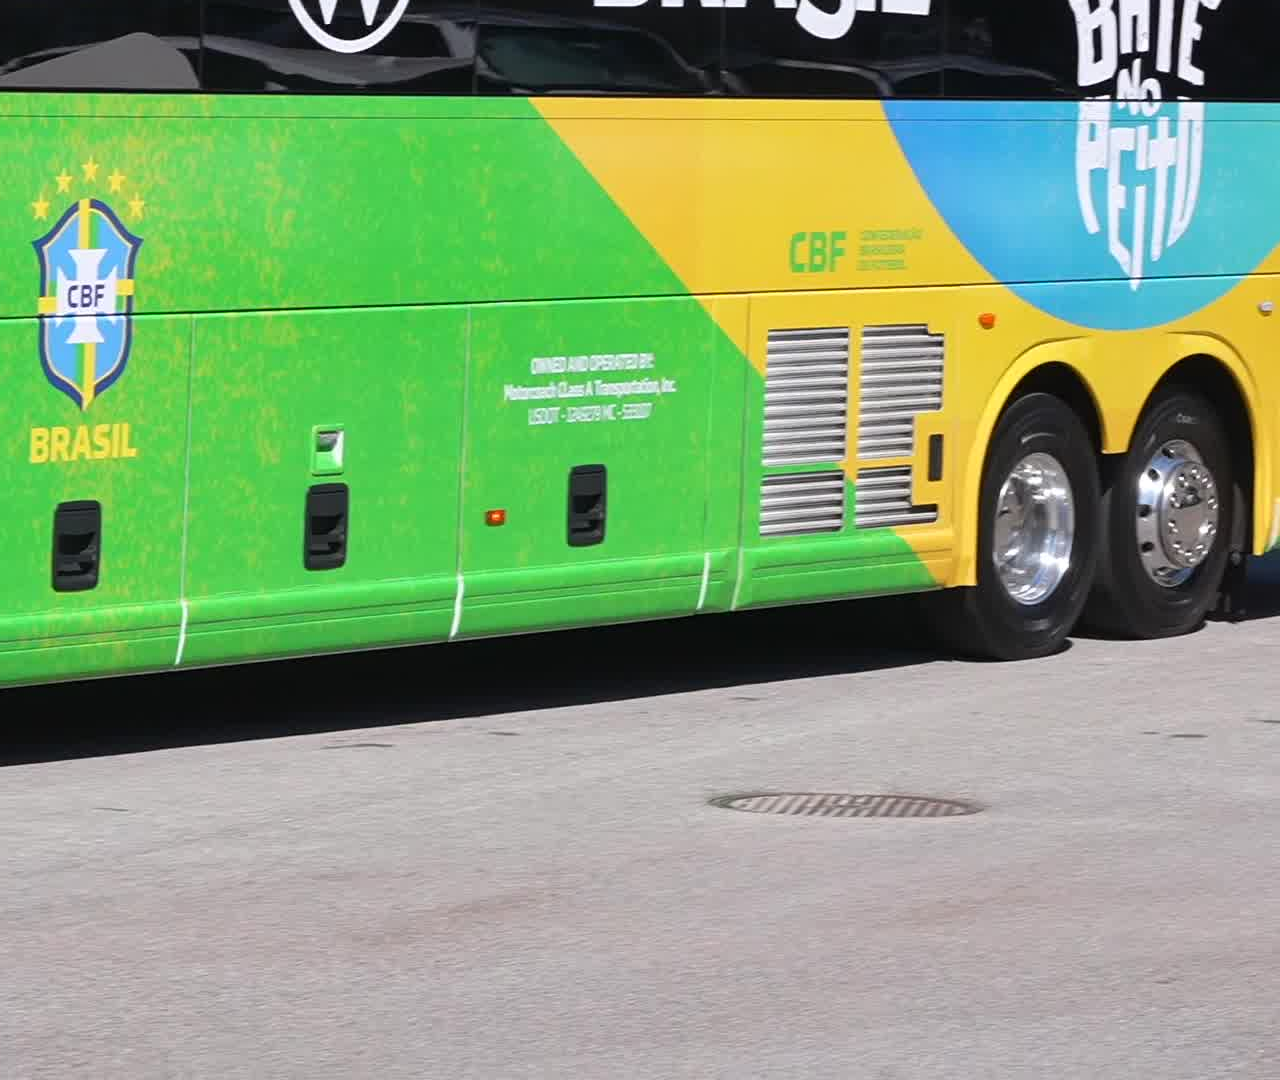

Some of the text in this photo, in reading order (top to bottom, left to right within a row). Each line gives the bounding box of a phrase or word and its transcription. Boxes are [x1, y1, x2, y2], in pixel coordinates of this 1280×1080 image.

[1075, 96, 1205, 291] PEITO
[789, 231, 847, 272] CBF
[66, 284, 106, 309] CBF
[28, 423, 137, 464] BRASIL
